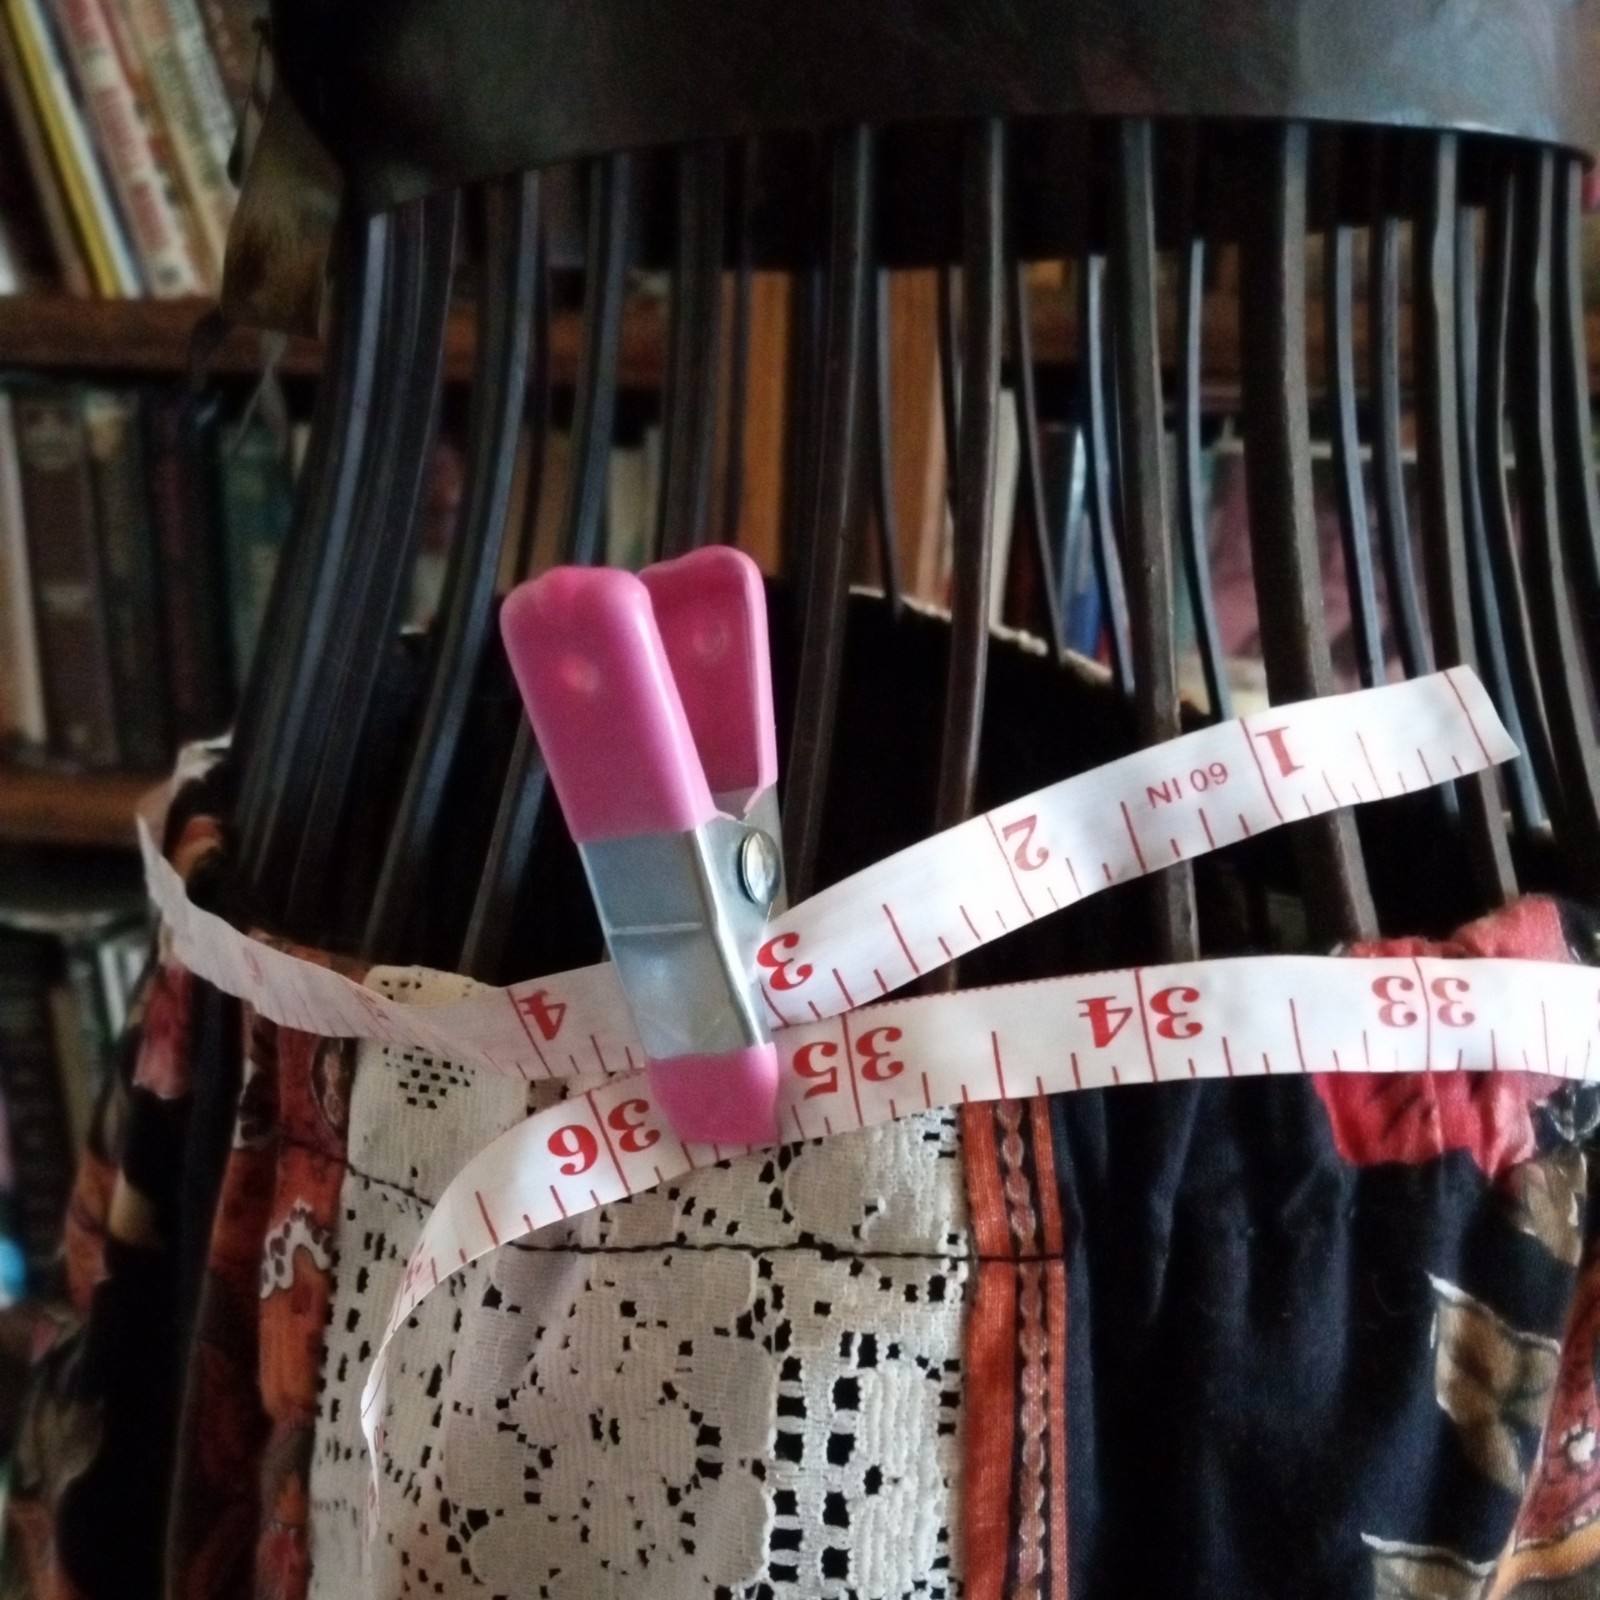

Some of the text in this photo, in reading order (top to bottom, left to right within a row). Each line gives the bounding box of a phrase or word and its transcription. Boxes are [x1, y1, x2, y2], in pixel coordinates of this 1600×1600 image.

[1255, 726, 1305, 778] 1
[1146, 761, 1229, 809] 60 IN
[1002, 814, 1049, 871] 2
[756, 931, 814, 991] 3
[518, 988, 568, 1041] 4
[1077, 986, 1204, 1049] 34
[1371, 975, 1475, 1028] 33
[792, 1026, 905, 1100] 35
[547, 1098, 661, 1176] 36
